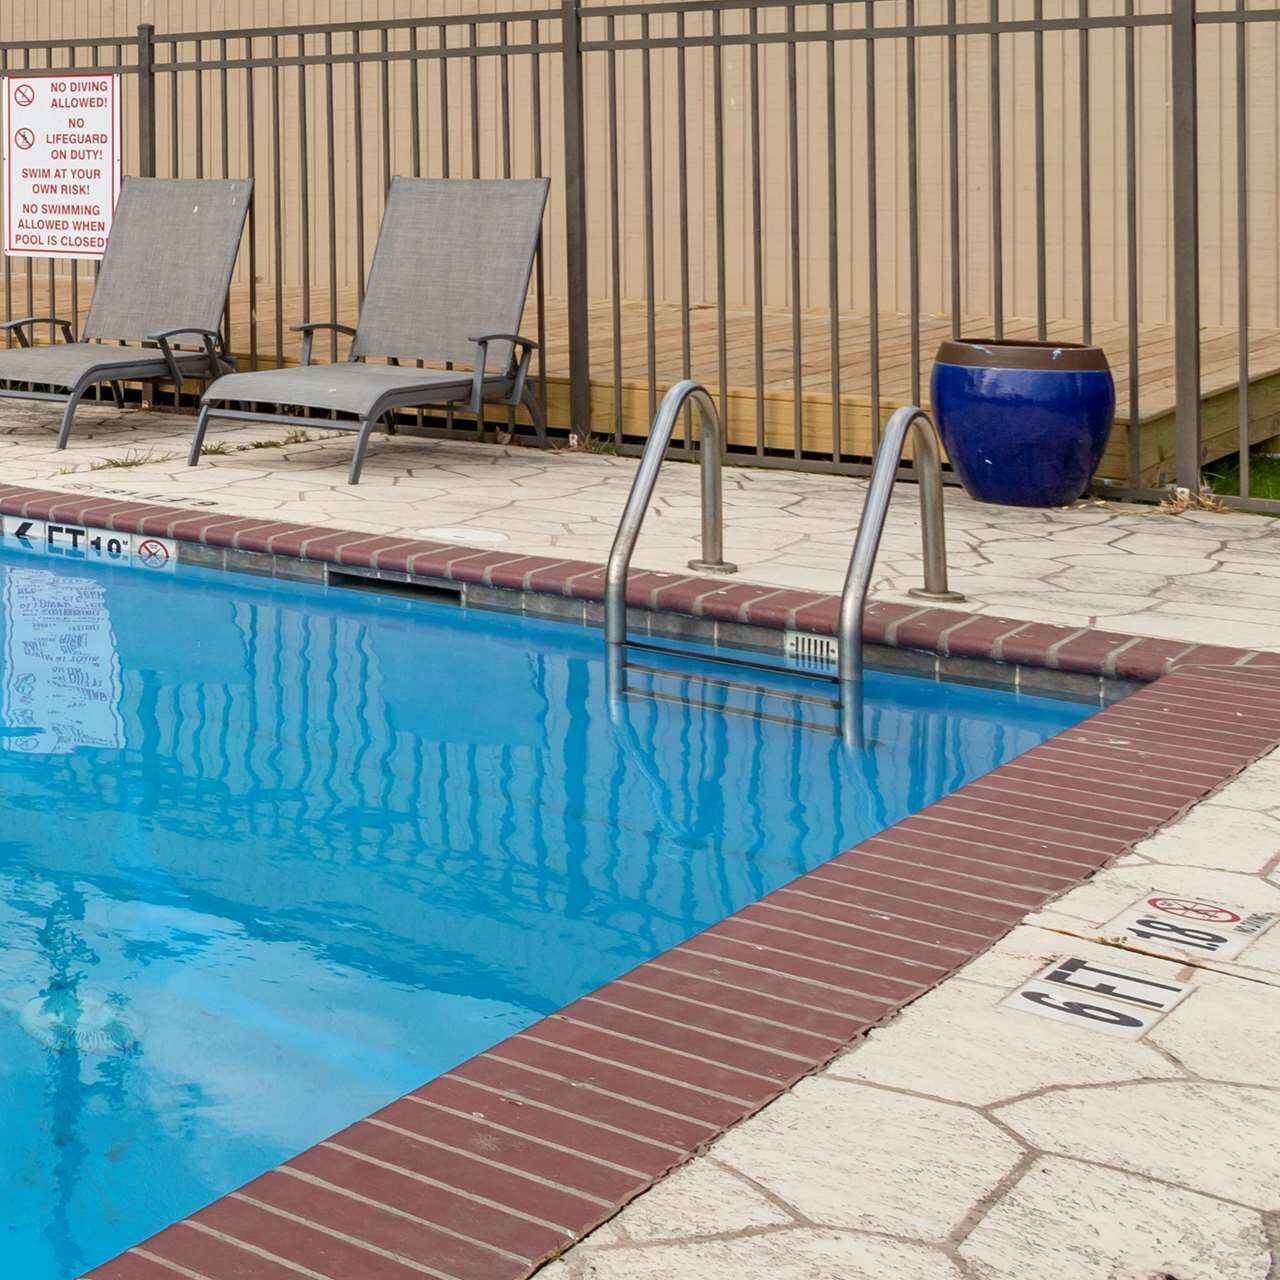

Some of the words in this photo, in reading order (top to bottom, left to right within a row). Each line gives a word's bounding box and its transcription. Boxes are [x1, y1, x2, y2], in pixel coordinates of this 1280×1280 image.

[51, 83, 66, 92] NO
[70, 82, 108, 92] DIVING
[51, 98, 107, 108] ALLOWED!
[69, 118, 84, 128] NO
[47, 134, 108, 144] LIFEGUARD
[51, 150, 66, 160] ON
[71, 150, 102, 160] DUTY!
[22, 169, 50, 179] SWIM
[54, 169, 68, 179] AT
[71, 169, 101, 179] YOUR
[32, 184, 57, 194] OWN
[61, 185, 89, 195] RISK!
[23, 204, 38, 214] NO
[42, 204, 100, 215] SWIMMING
[18, 220, 68, 230] ALLOWED
[73, 221, 105, 231] WHEN
[16, 235, 43, 245] POOL
[48, 236, 57, 245] IS
[1044, 957, 1183, 1008] FT
[1021, 991, 1144, 1028] 6
